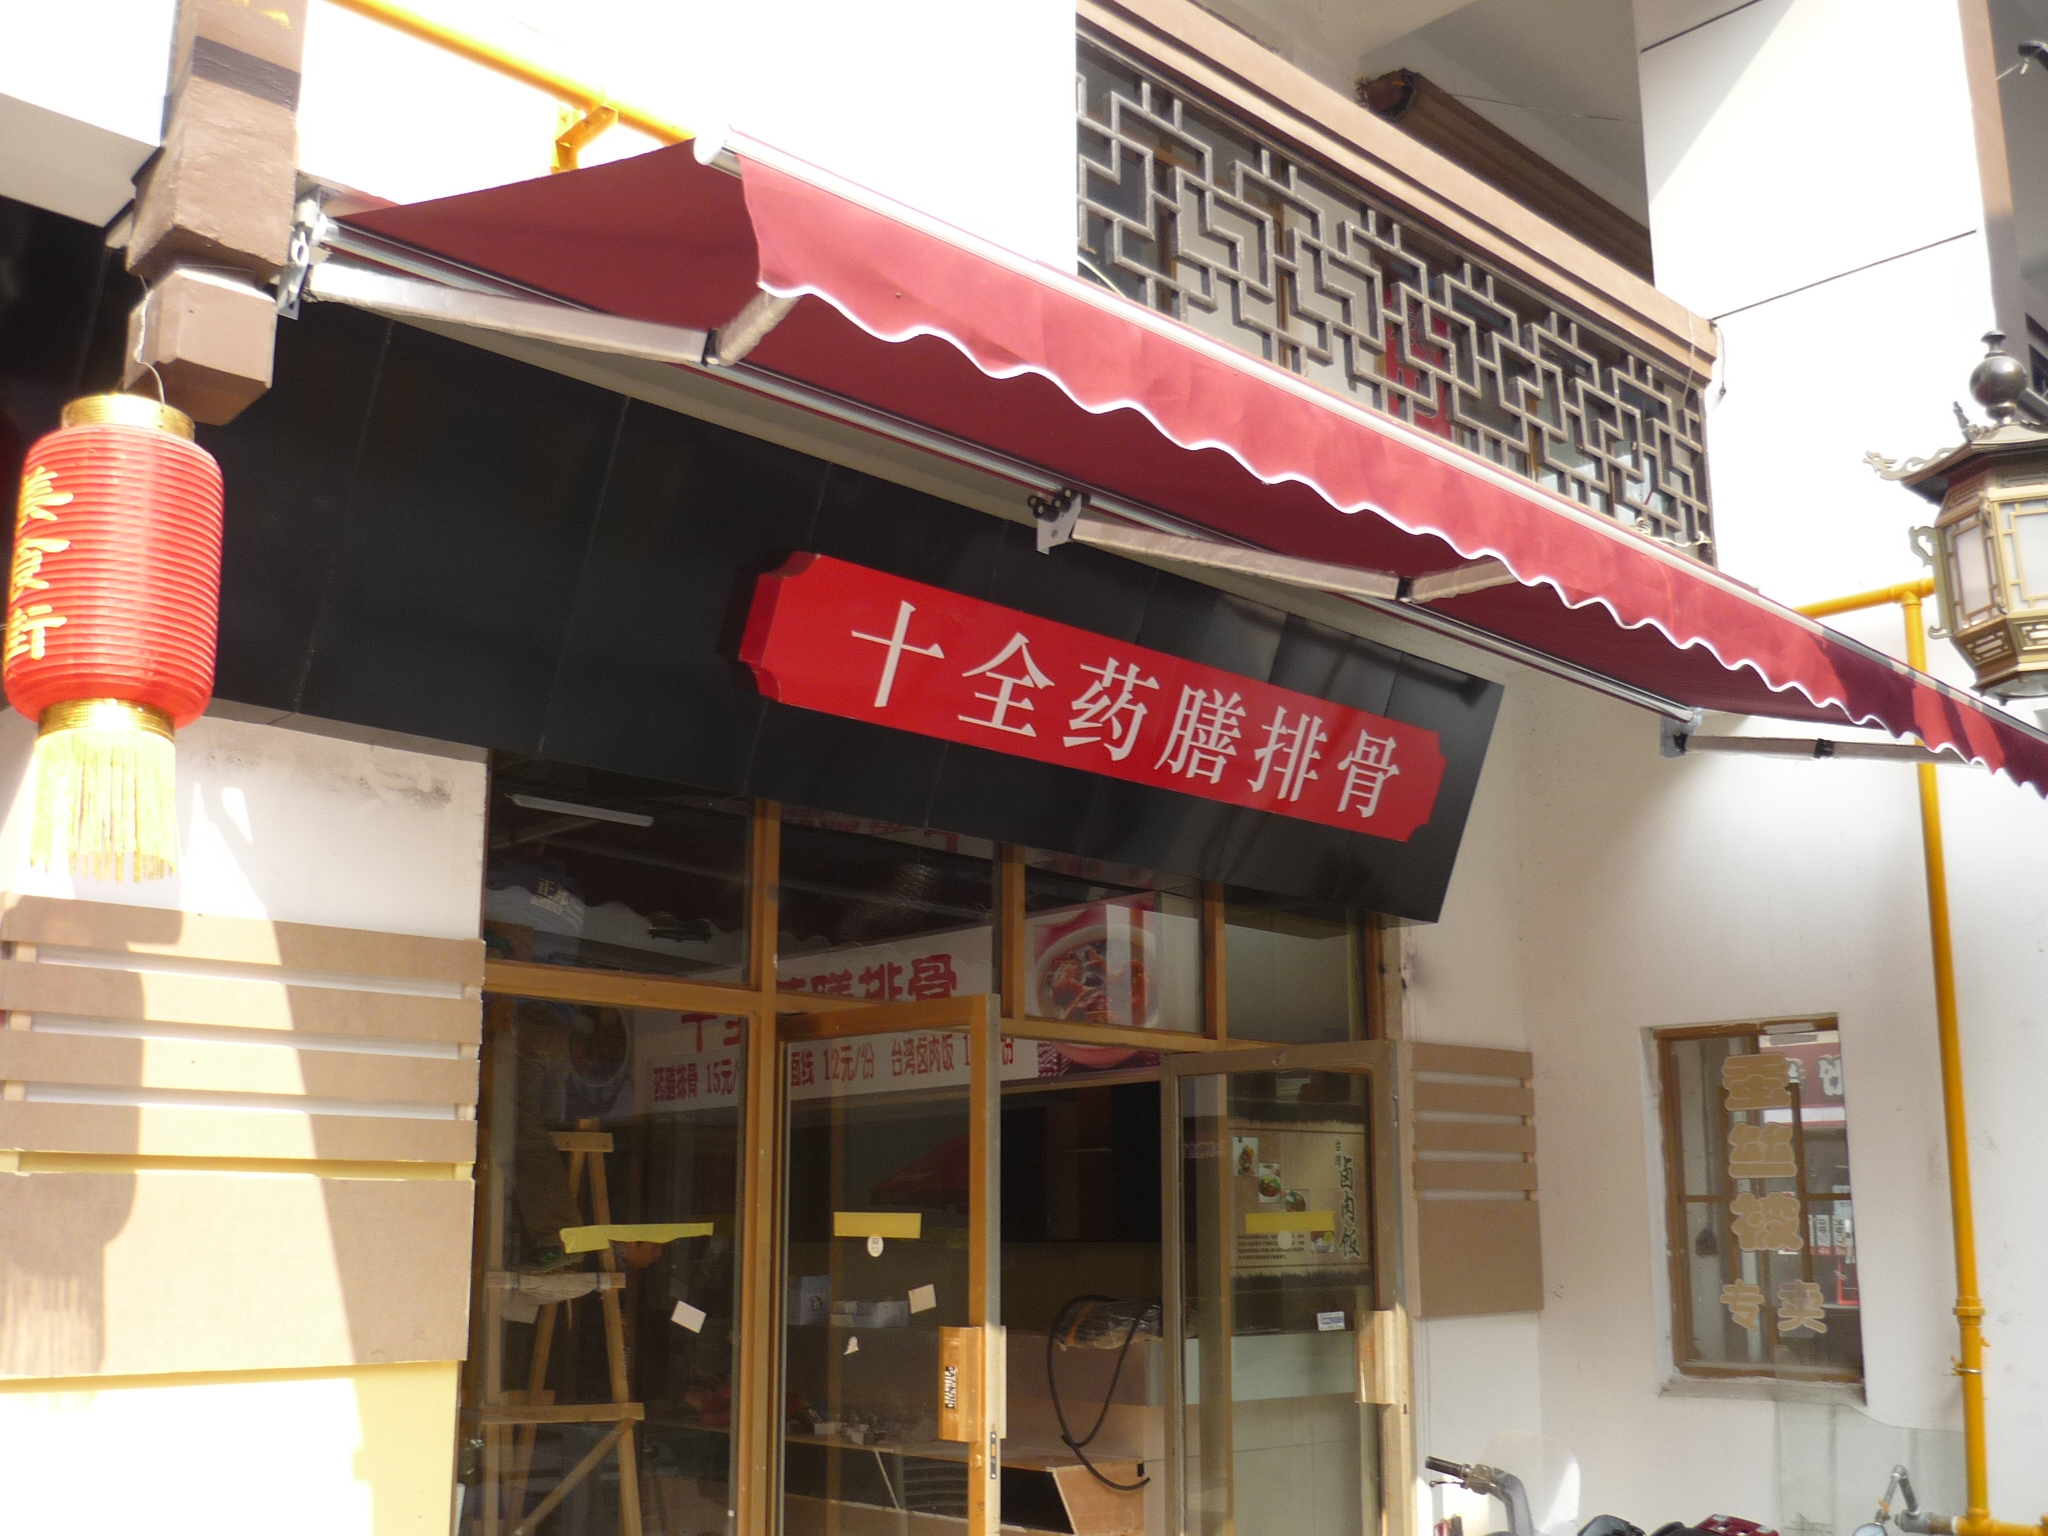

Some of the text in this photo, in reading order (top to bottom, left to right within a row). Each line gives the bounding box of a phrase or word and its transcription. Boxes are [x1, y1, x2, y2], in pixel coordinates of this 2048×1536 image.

[850, 600, 1400, 818] 十全药膳排骨
[1720, 1279, 1827, 1333] 专卖
